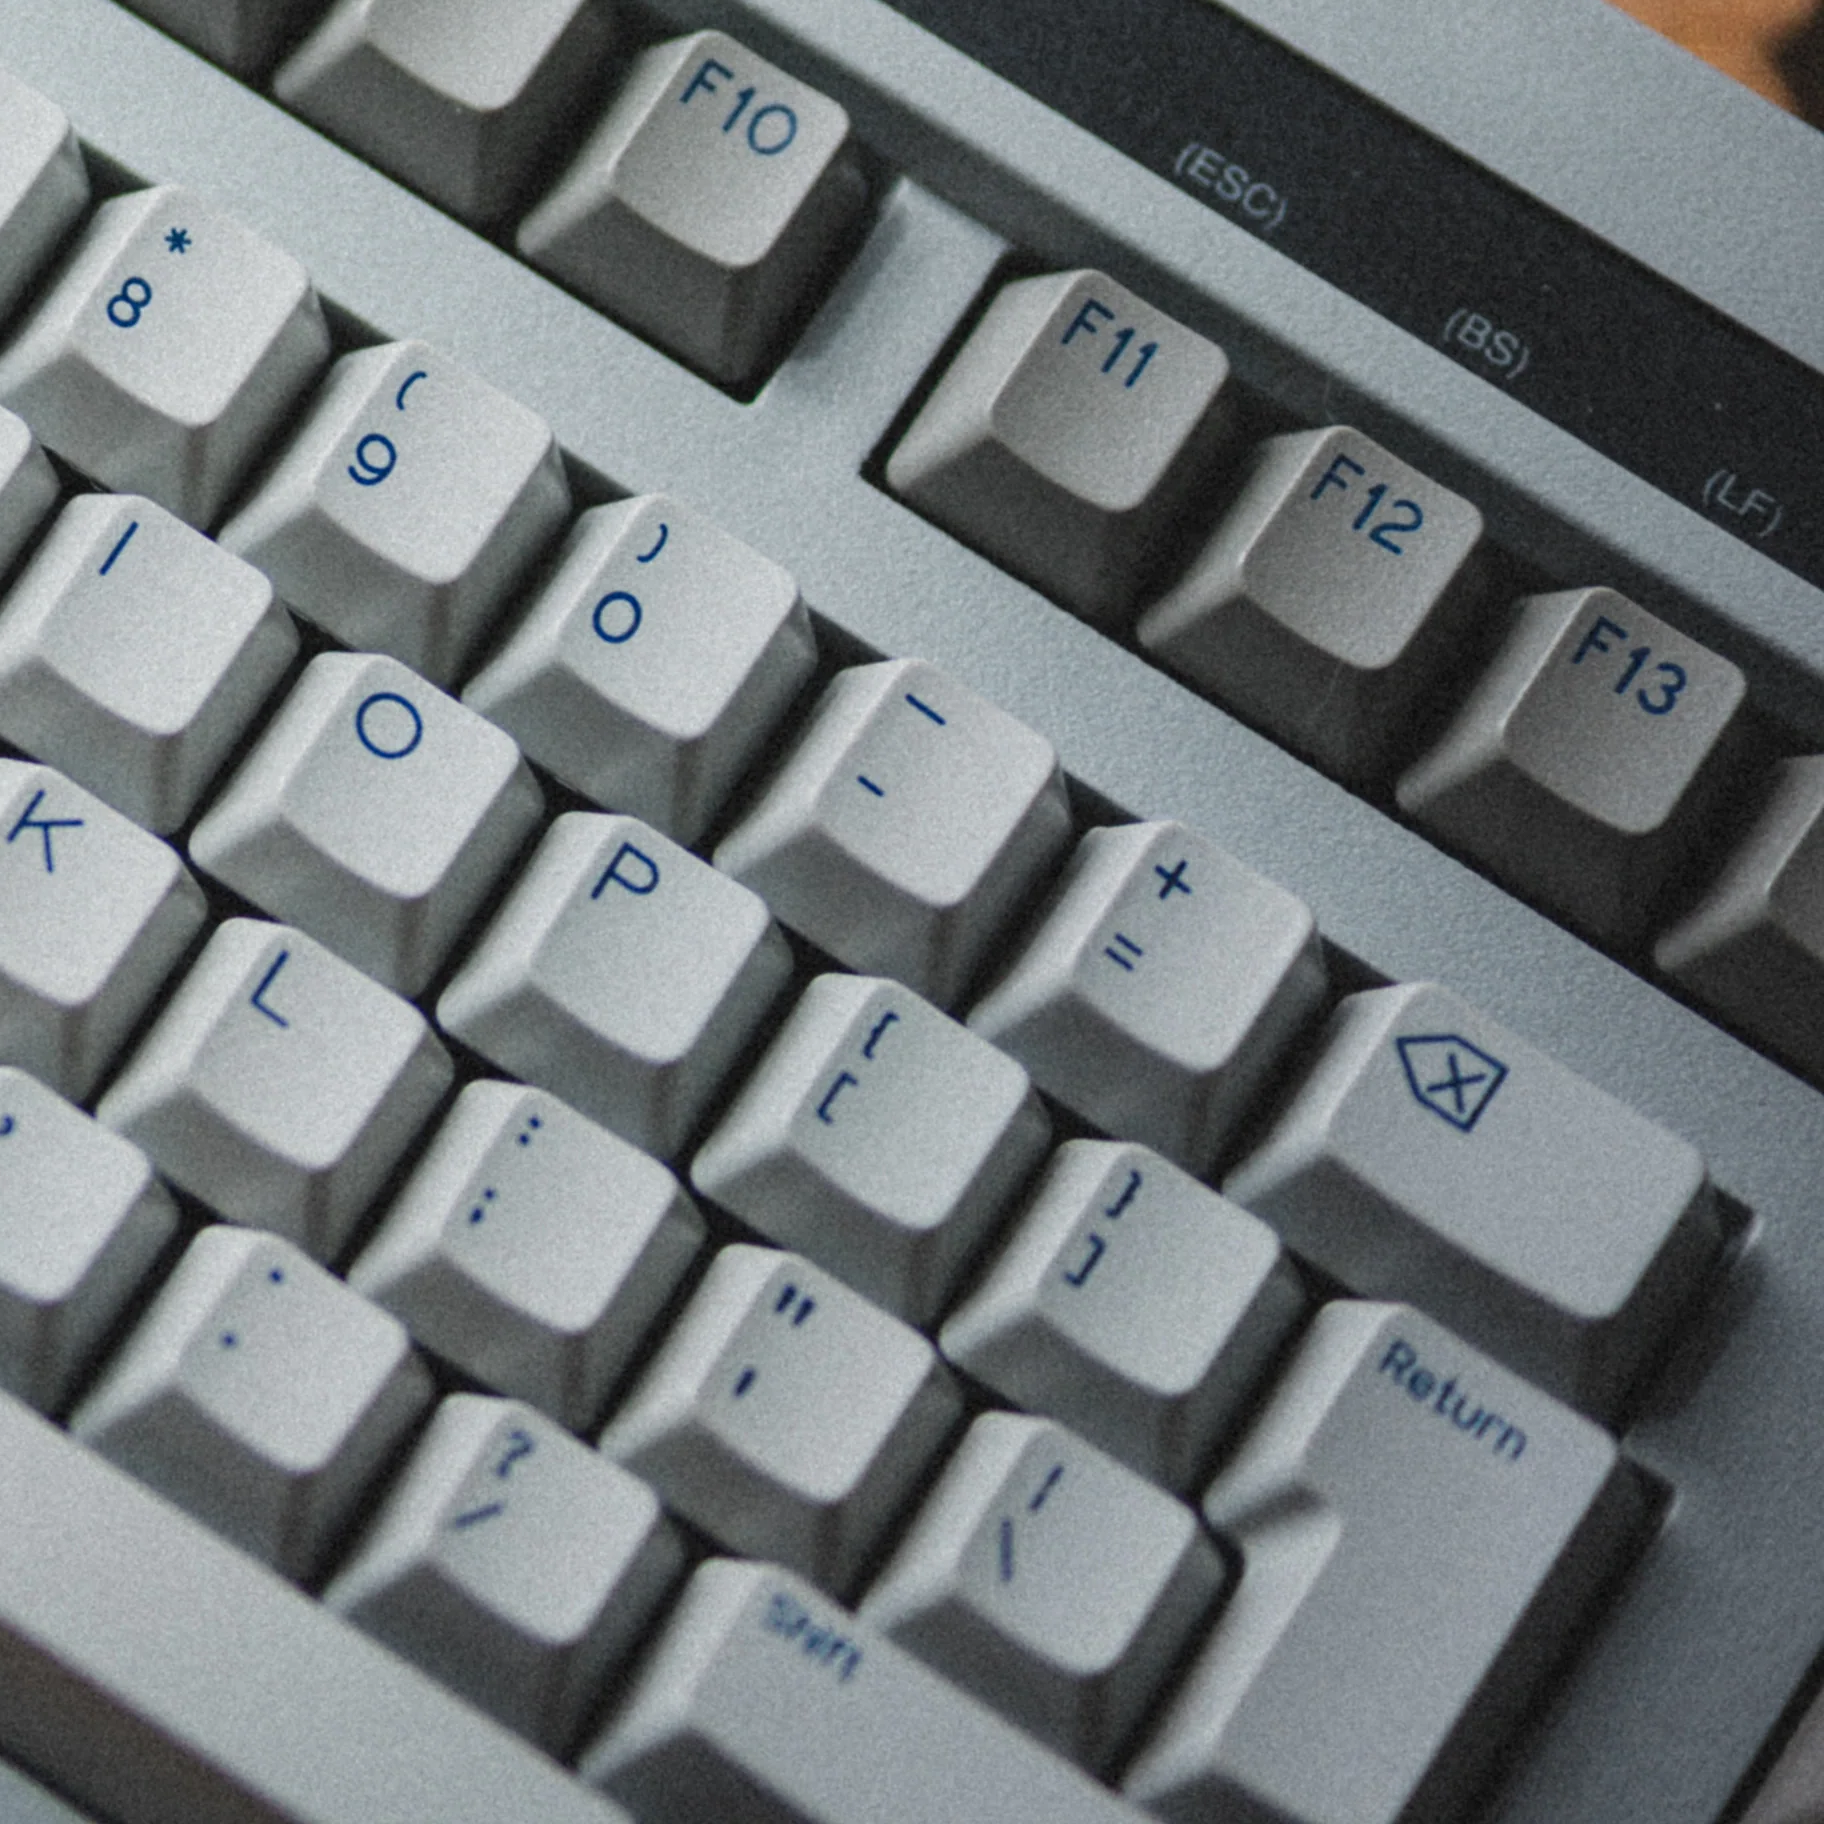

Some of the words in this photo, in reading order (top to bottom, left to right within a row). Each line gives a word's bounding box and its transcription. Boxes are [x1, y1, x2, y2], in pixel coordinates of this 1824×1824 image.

[678, 58, 797, 155] F10
[1174, 142, 1289, 232] (ESC)
[106, 276, 152, 328] 8
[1060, 298, 1158, 388] F11
[1443, 307, 1531, 380] (BS)
[348, 433, 397, 486] 9
[1309, 452, 1423, 555] F12
[1701, 469, 1784, 539] (LF)
[99, 521, 139, 576] I
[1569, 614, 1686, 715] F13
[355, 692, 423, 760] O
[6, 789, 84, 873] K
[590, 842, 660, 900] P
[1154, 860, 1191, 900] +
[250, 950, 289, 1027] L
[815, 1071, 858, 1125] [
[1063, 1233, 1107, 1288] ]
[1377, 1338, 1526, 1459] Return
